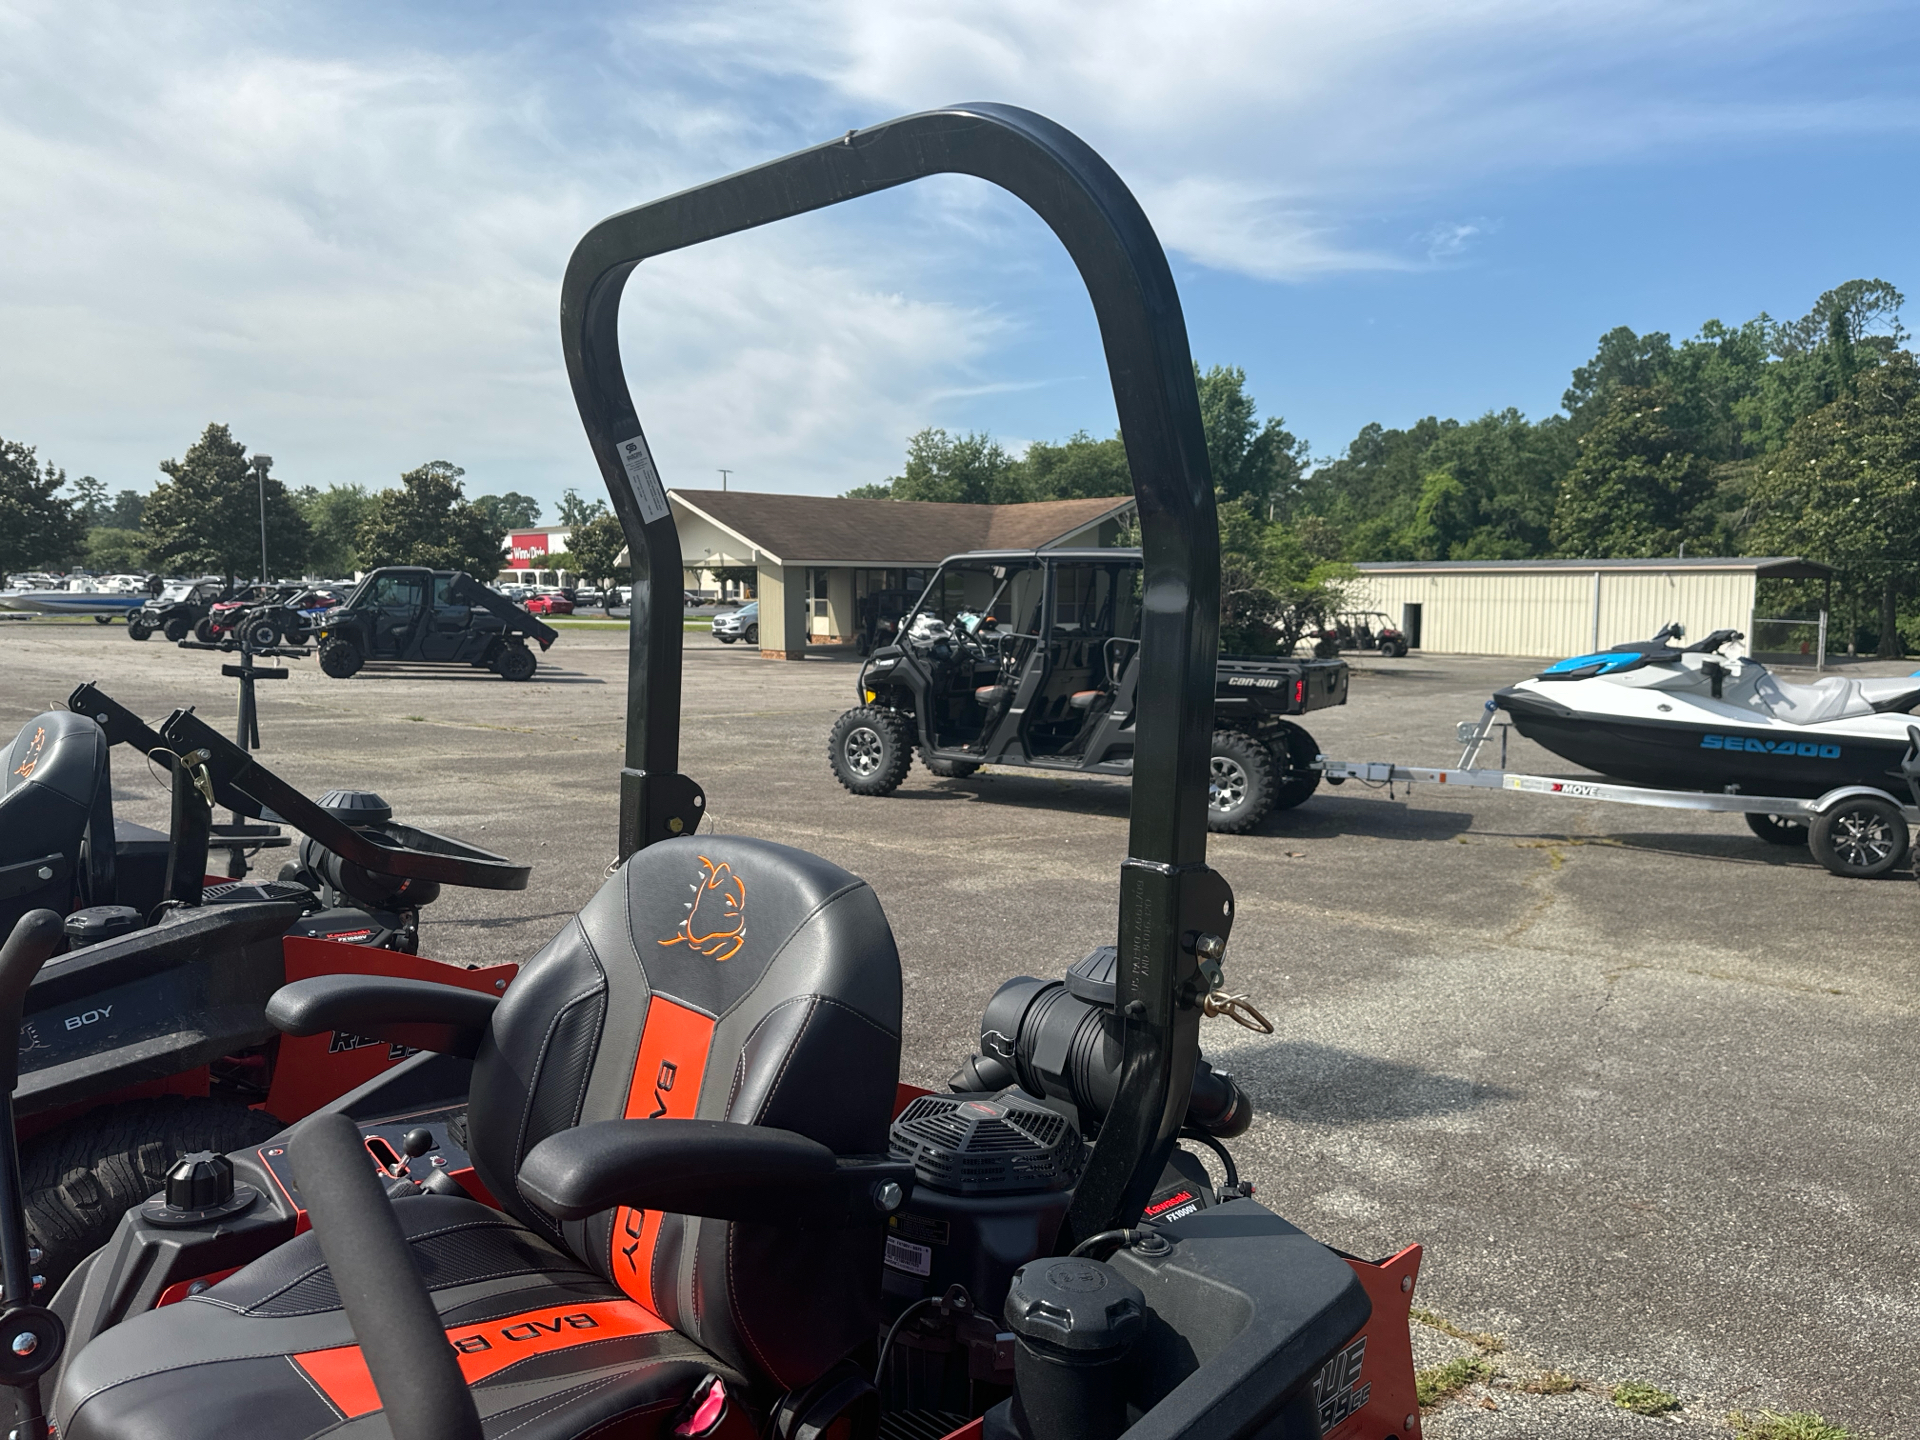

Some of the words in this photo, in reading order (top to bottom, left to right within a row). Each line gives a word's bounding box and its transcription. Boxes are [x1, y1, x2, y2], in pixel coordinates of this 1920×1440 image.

[1228, 677, 1279, 688] can-am
[1561, 784, 1598, 796] MOVE
[1141, 955, 1150, 976] AND
[64, 1004, 113, 1031] BOY
[649, 1059, 677, 1119] BA
[1144, 1190, 1192, 1216] Kawasaki
[1165, 1203, 1198, 1223] FX1000V
[622, 1206, 645, 1276] OY
[501, 1313, 599, 1341] BAD
